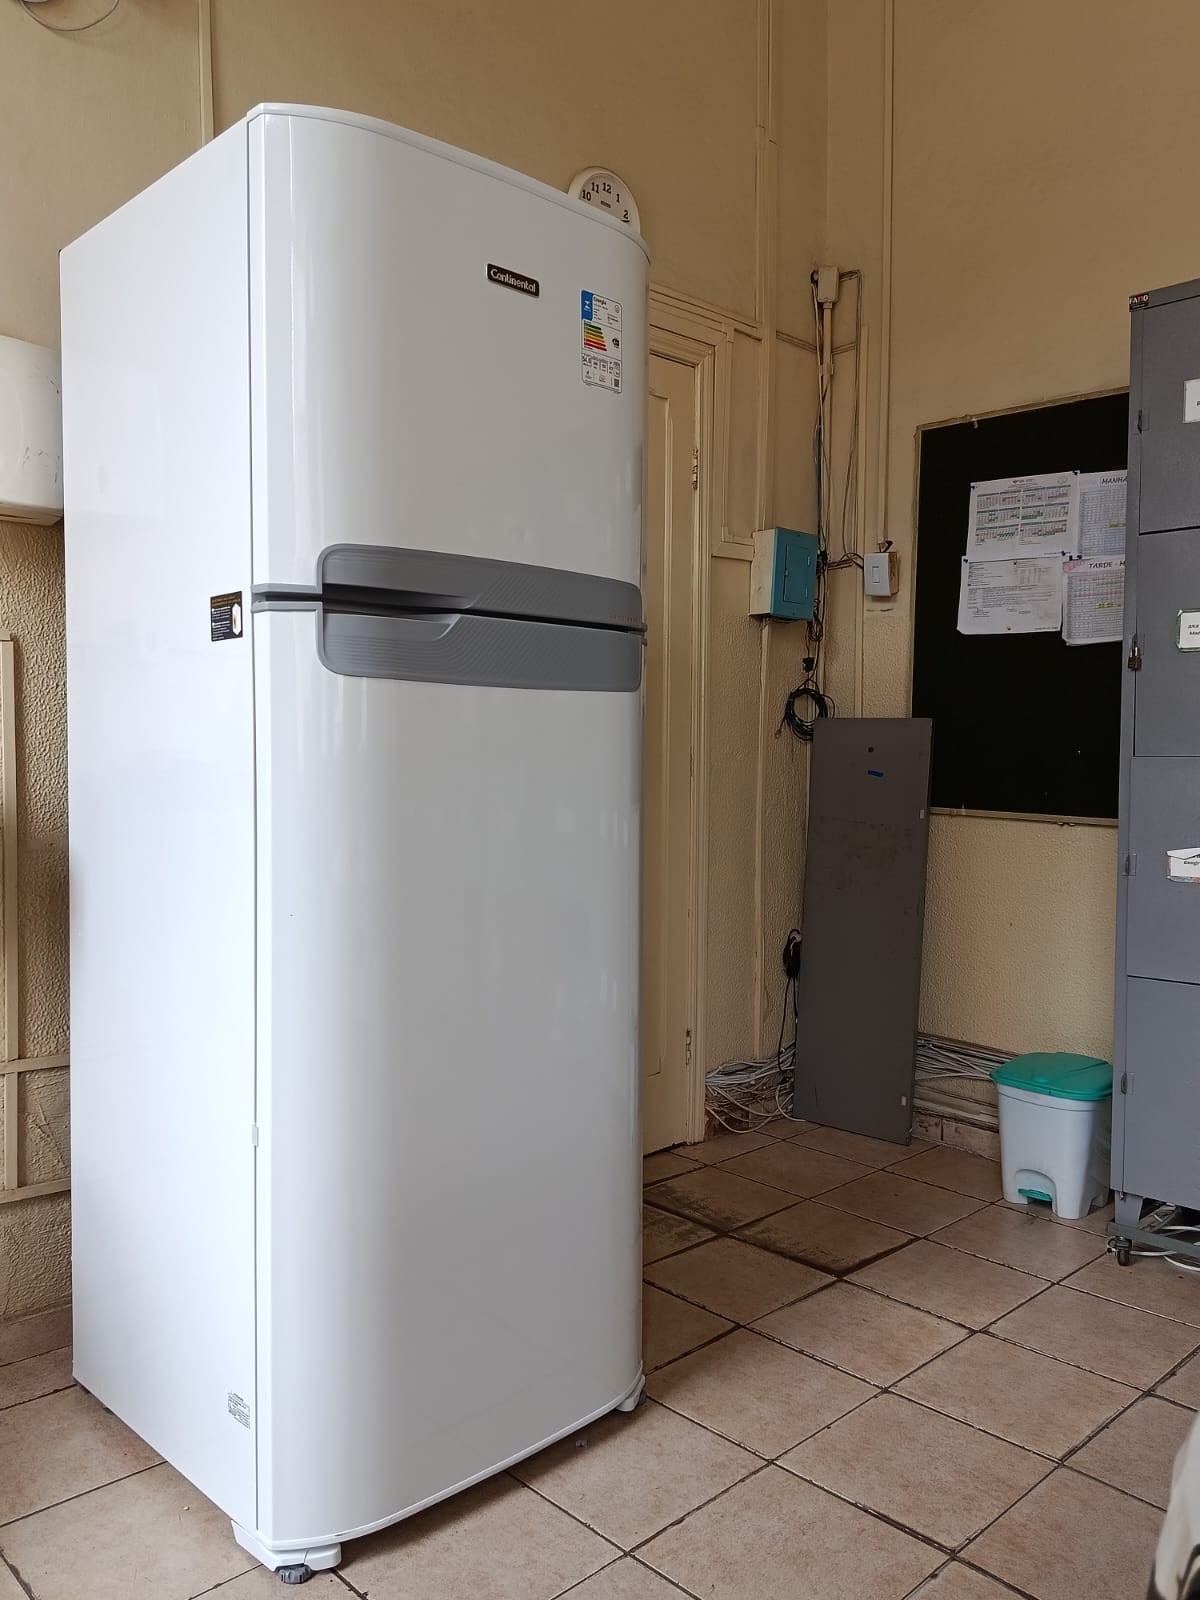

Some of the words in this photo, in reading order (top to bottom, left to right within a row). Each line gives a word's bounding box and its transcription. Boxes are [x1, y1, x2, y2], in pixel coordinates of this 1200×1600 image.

[591, 182, 600, 194] 11
[602, 182, 612, 195] 12
[582, 189, 592, 201] 10
[616, 193, 620, 203] 1
[623, 209, 629, 219] 2
[490, 268, 536, 293] Continental
